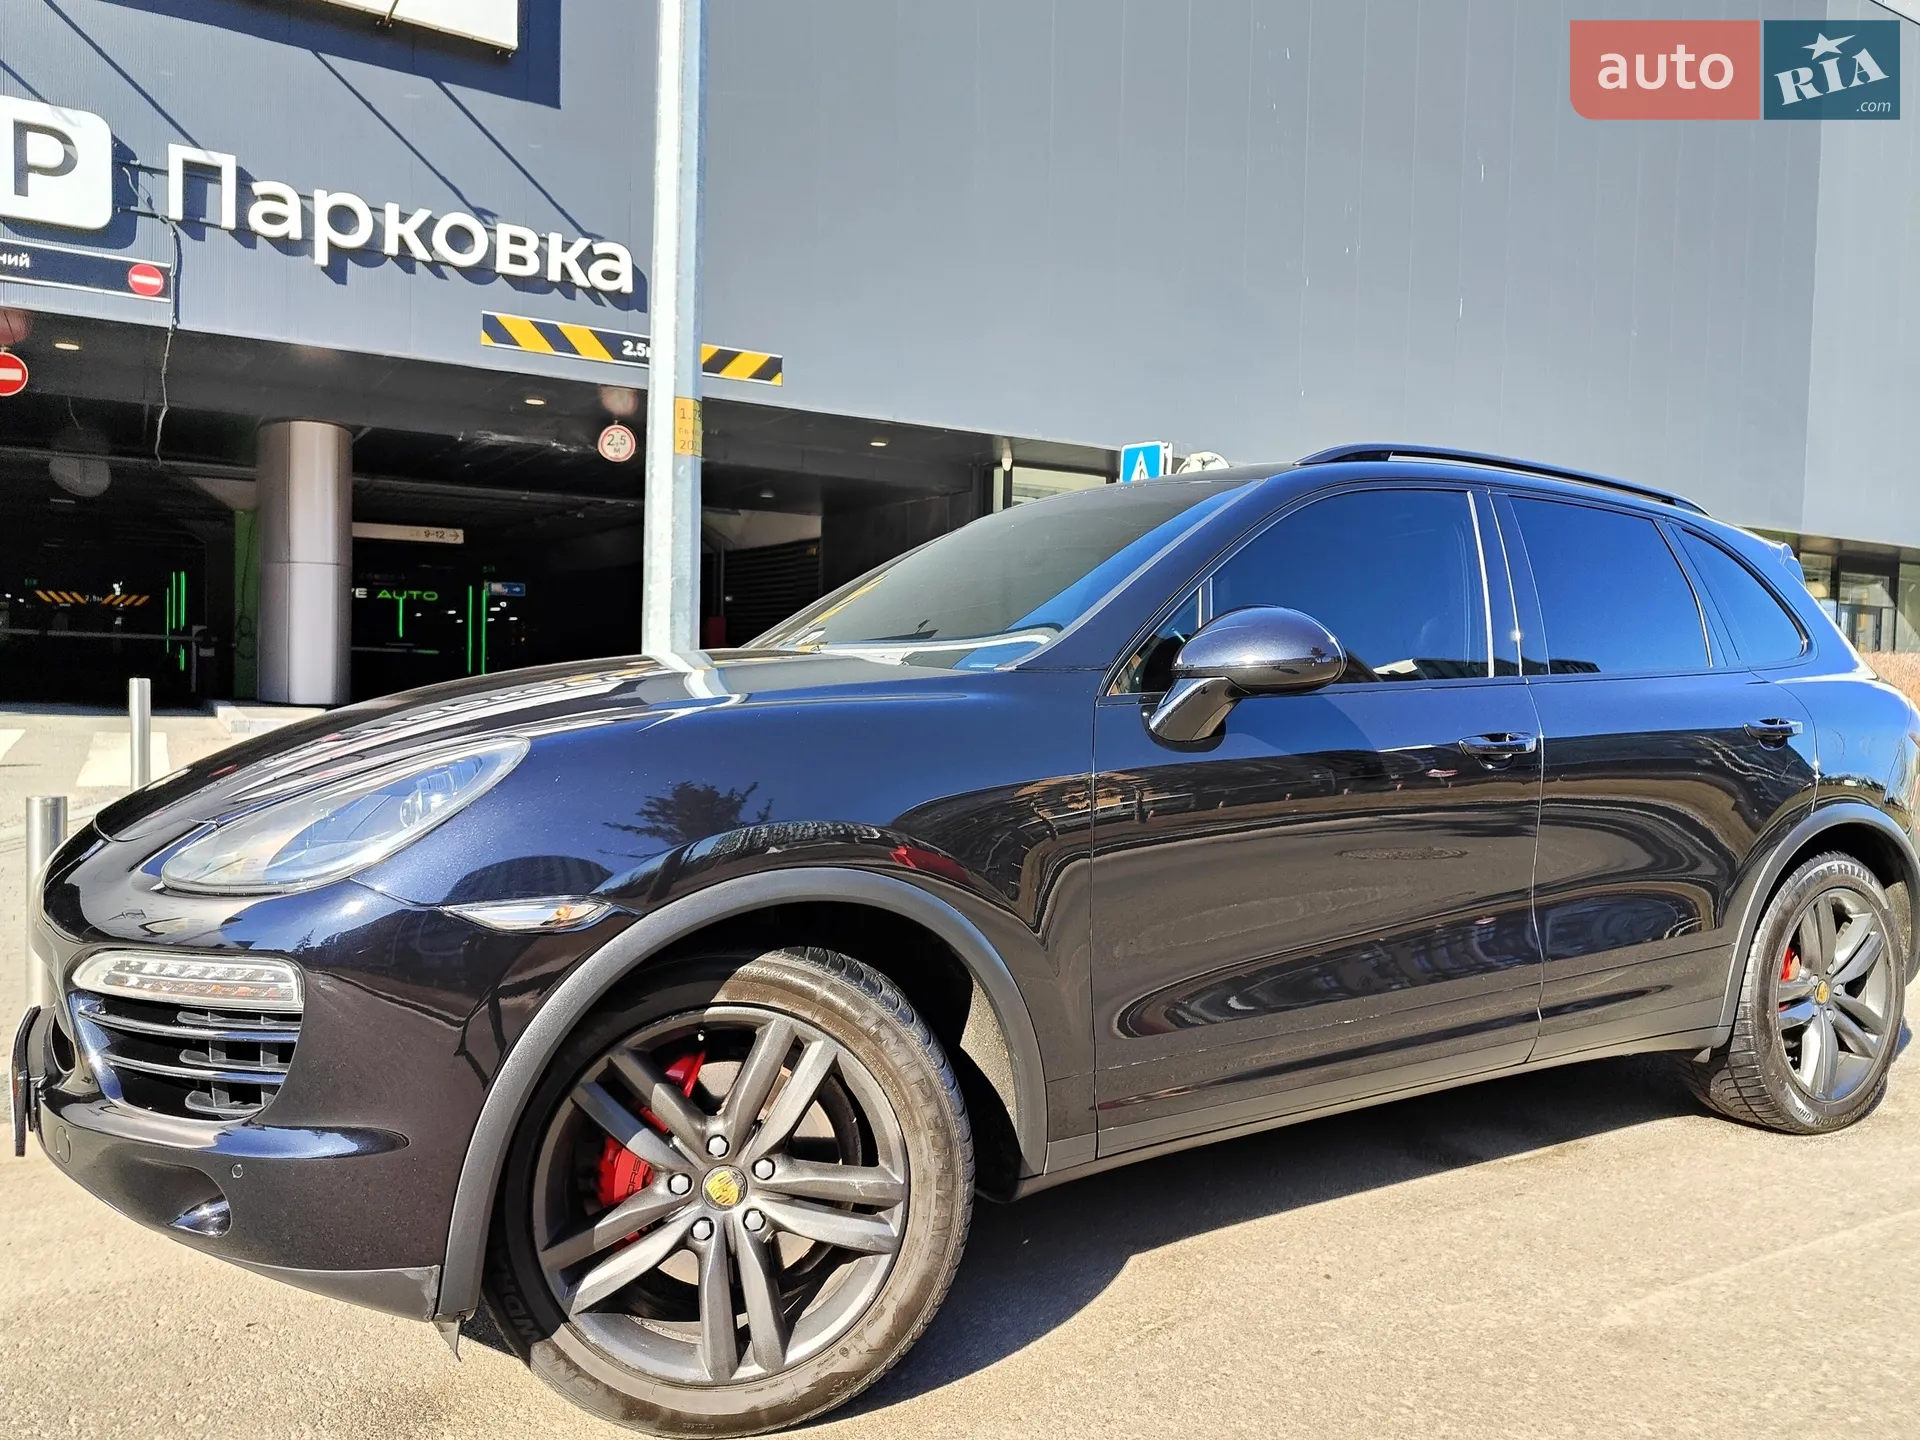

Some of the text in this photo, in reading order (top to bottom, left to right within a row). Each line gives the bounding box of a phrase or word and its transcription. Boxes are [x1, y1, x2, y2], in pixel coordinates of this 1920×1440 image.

[13, 118, 79, 198] P
[168, 143, 634, 294] Парковка
[377, 589, 438, 601] AUTO
